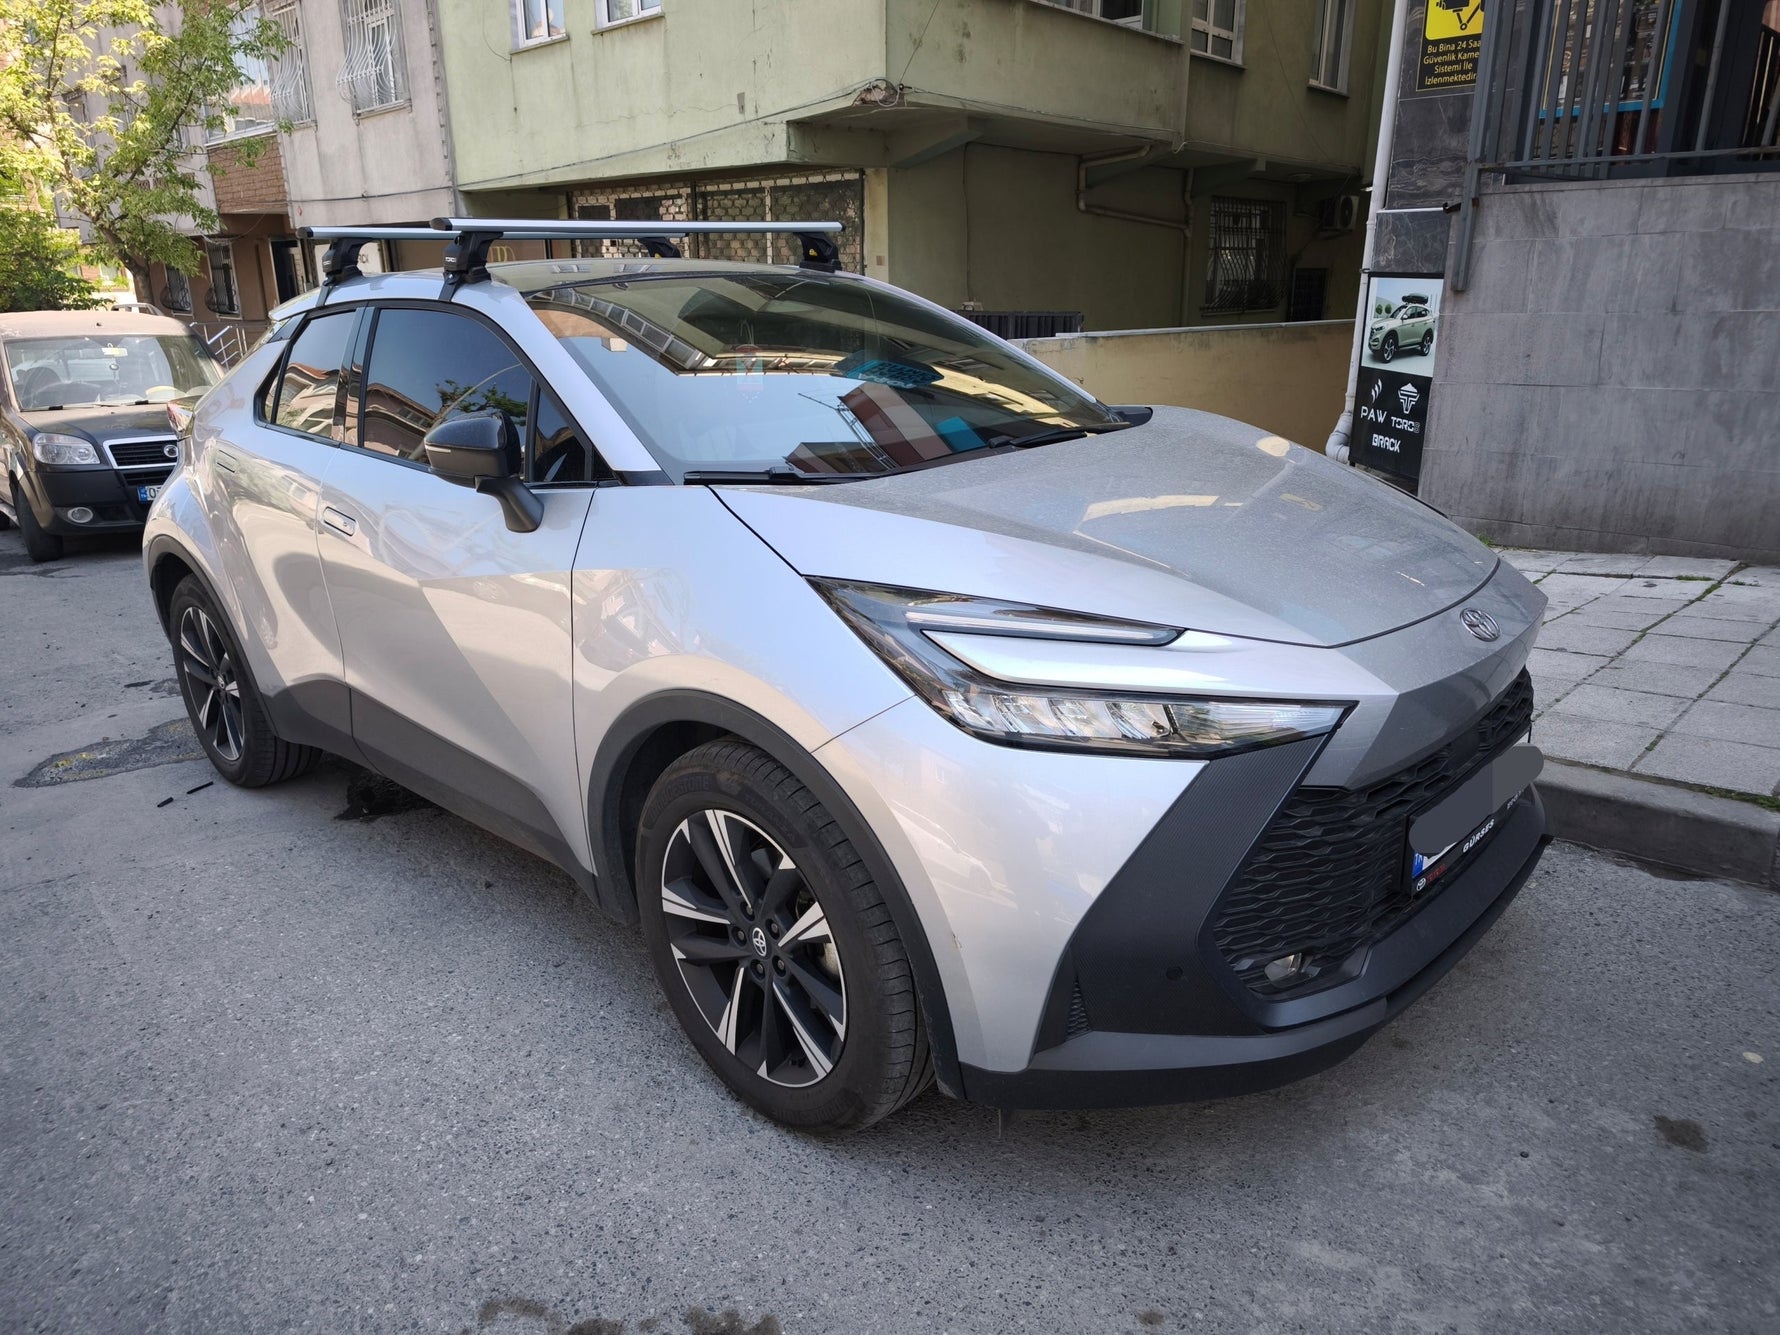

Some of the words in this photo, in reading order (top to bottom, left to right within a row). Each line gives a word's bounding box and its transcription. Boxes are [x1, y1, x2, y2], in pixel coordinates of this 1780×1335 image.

[1427, 45, 1437, 53] Bu
[1439, 43, 1455, 52] Bina
[1457, 41, 1467, 50] 24
[1468, 40, 1481, 48] Saa
[1423, 53, 1456, 64] Güvenlik
[1458, 51, 1480, 60] Kame
[1434, 62, 1462, 74] Sistemi
[1360, 406, 1387, 424] PAW
[1371, 433, 1401, 453] BRACK
[1462, 818, 1495, 853] GÜRSES
